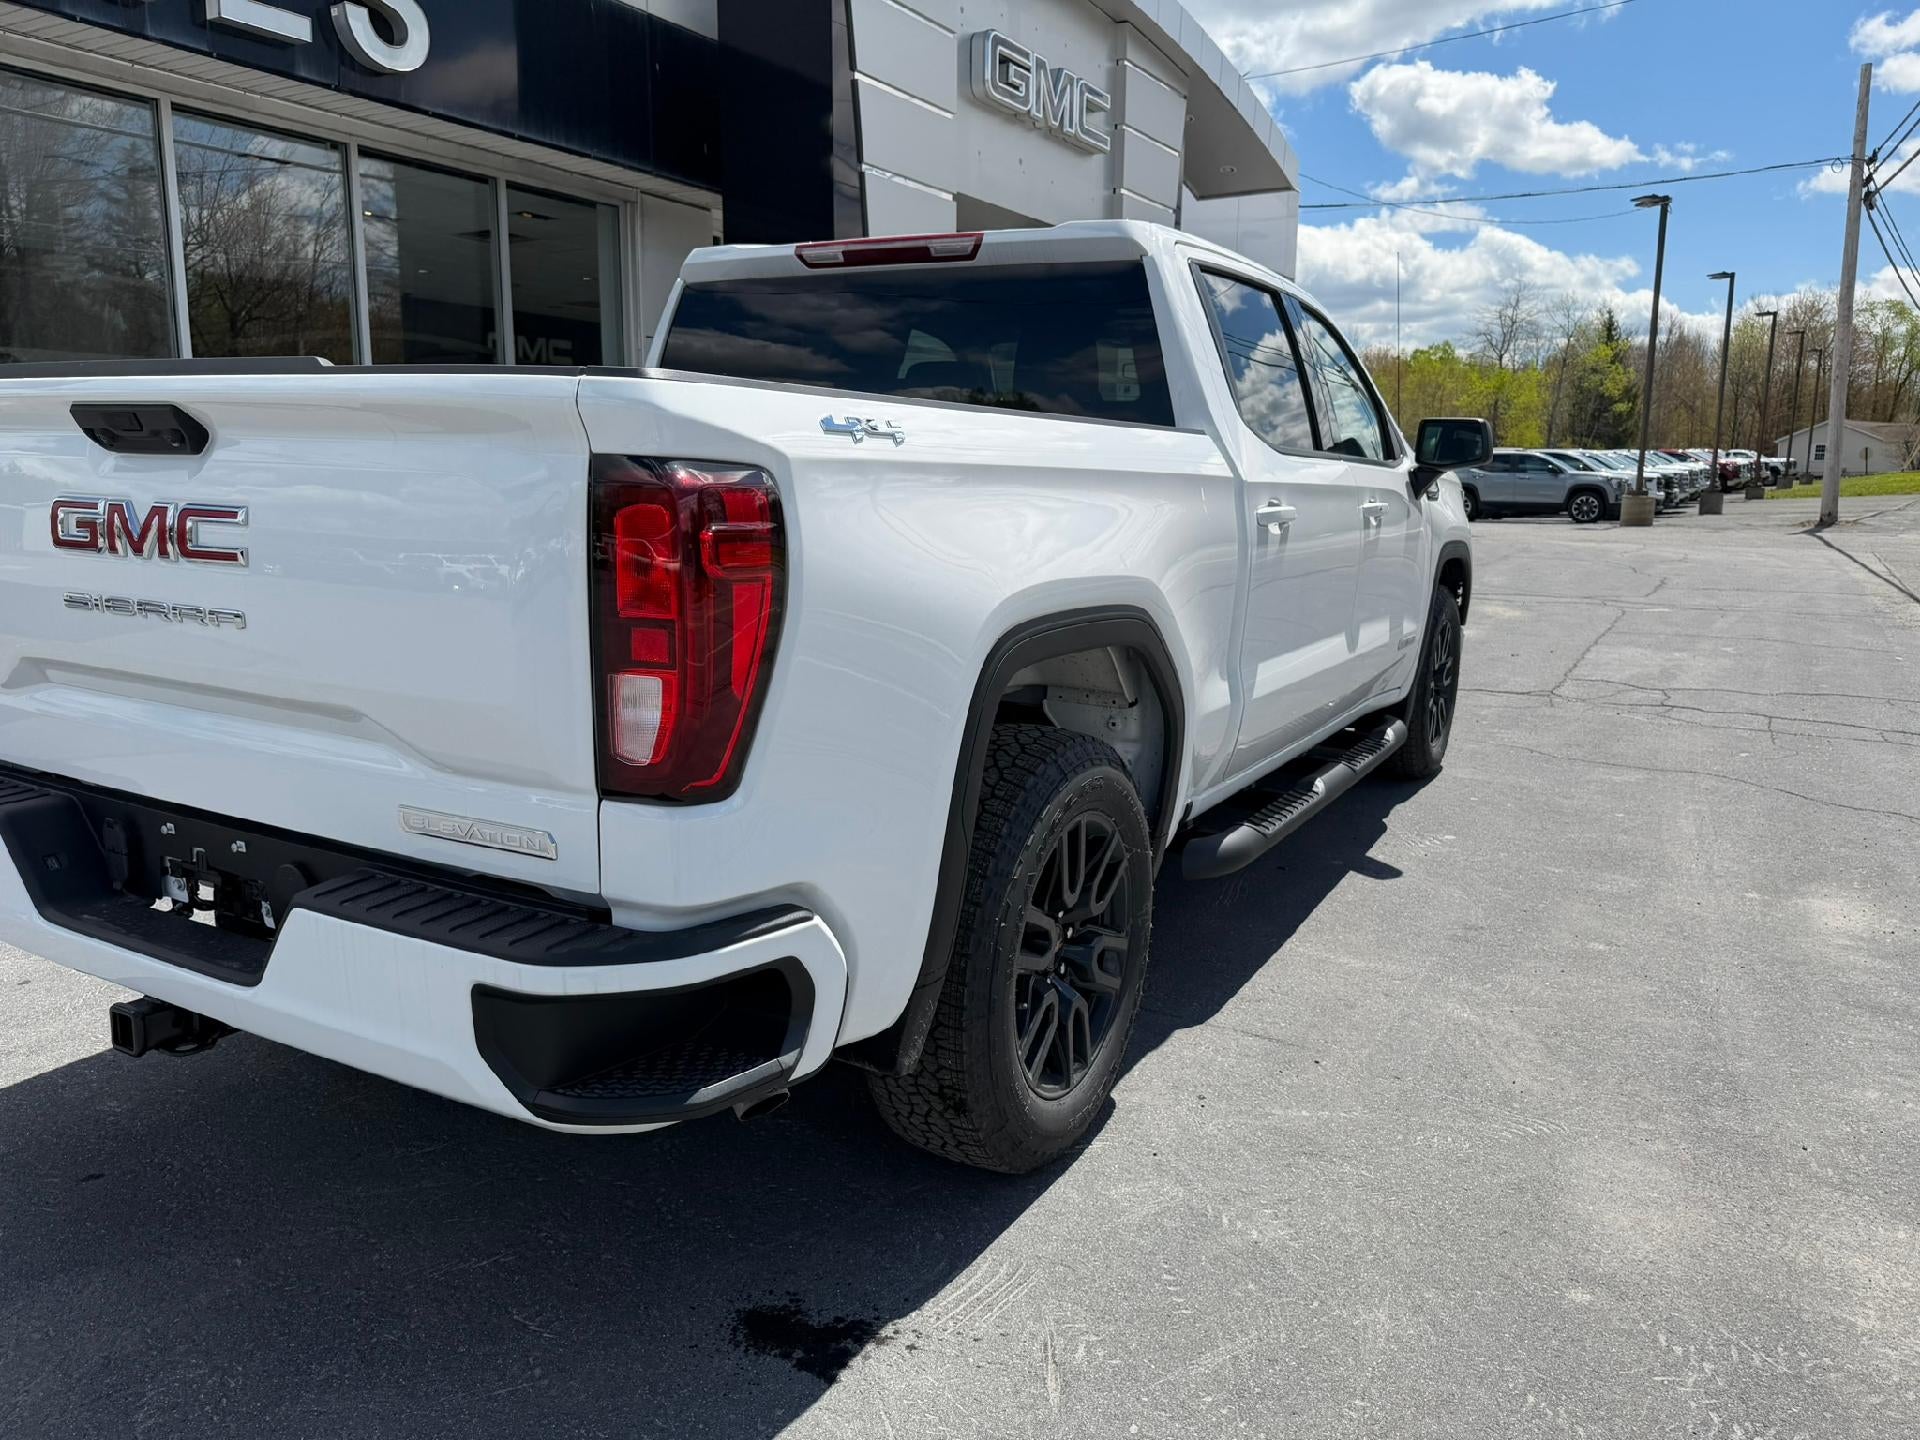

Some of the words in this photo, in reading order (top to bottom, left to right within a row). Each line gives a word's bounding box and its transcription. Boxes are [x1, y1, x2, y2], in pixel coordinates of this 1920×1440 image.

[972, 30, 1111, 153] GMC
[50, 496, 248, 567] GMC
[63, 591, 247, 630] SIERRA
[409, 814, 544, 851] ELEVATION
